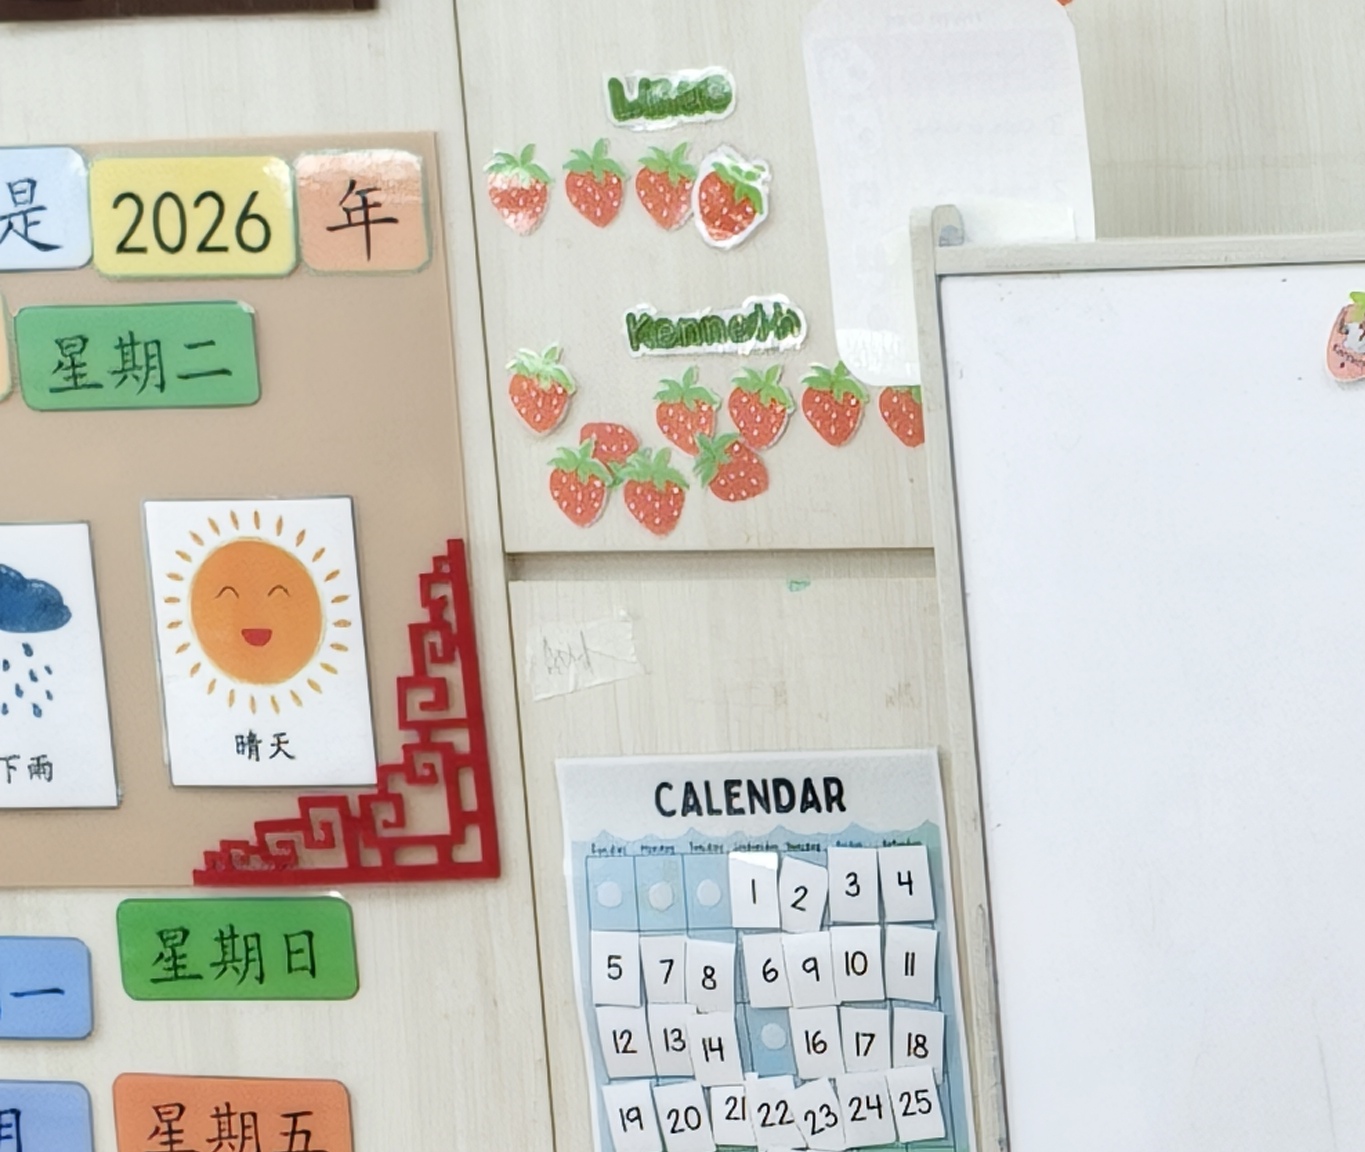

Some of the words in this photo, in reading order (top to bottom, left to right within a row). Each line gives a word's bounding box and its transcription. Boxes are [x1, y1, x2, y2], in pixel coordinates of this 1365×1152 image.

[0, 177, 61, 252] 是
[112, 190, 272, 255] 2026
[326, 179, 399, 261] 年
[625, 302, 802, 351] Kenneth
[49, 330, 233, 394] 星期二
[234, 730, 295, 762] 晴天
[0, 754, 53, 784] 下雨
[654, 776, 847, 818] CALENDAR
[751, 878, 757, 905] 1
[790, 885, 808, 912] 2
[845, 871, 861, 898] 3
[897, 870, 913, 896] 4
[150, 923, 316, 985] 星期日
[607, 954, 623, 981] 5
[659, 958, 674, 985] 7
[701, 965, 717, 991] 8
[762, 958, 779, 983] 6
[801, 956, 820, 982] 9
[844, 950, 868, 977] 10
[904, 951, 916, 977] 11
[612, 1029, 638, 1054] 12
[663, 1027, 687, 1052] 13
[701, 1036, 725, 1063] 14
[804, 1030, 828, 1055] 16
[855, 1031, 876, 1057] 17
[907, 1032, 929, 1059] 18
[619, 1106, 644, 1133] 19
[666, 1105, 702, 1134] 20
[725, 1095, 746, 1121] 21
[757, 1099, 795, 1128] 22
[803, 1103, 838, 1136] 23
[848, 1094, 883, 1122] 24
[899, 1088, 932, 1117] 25
